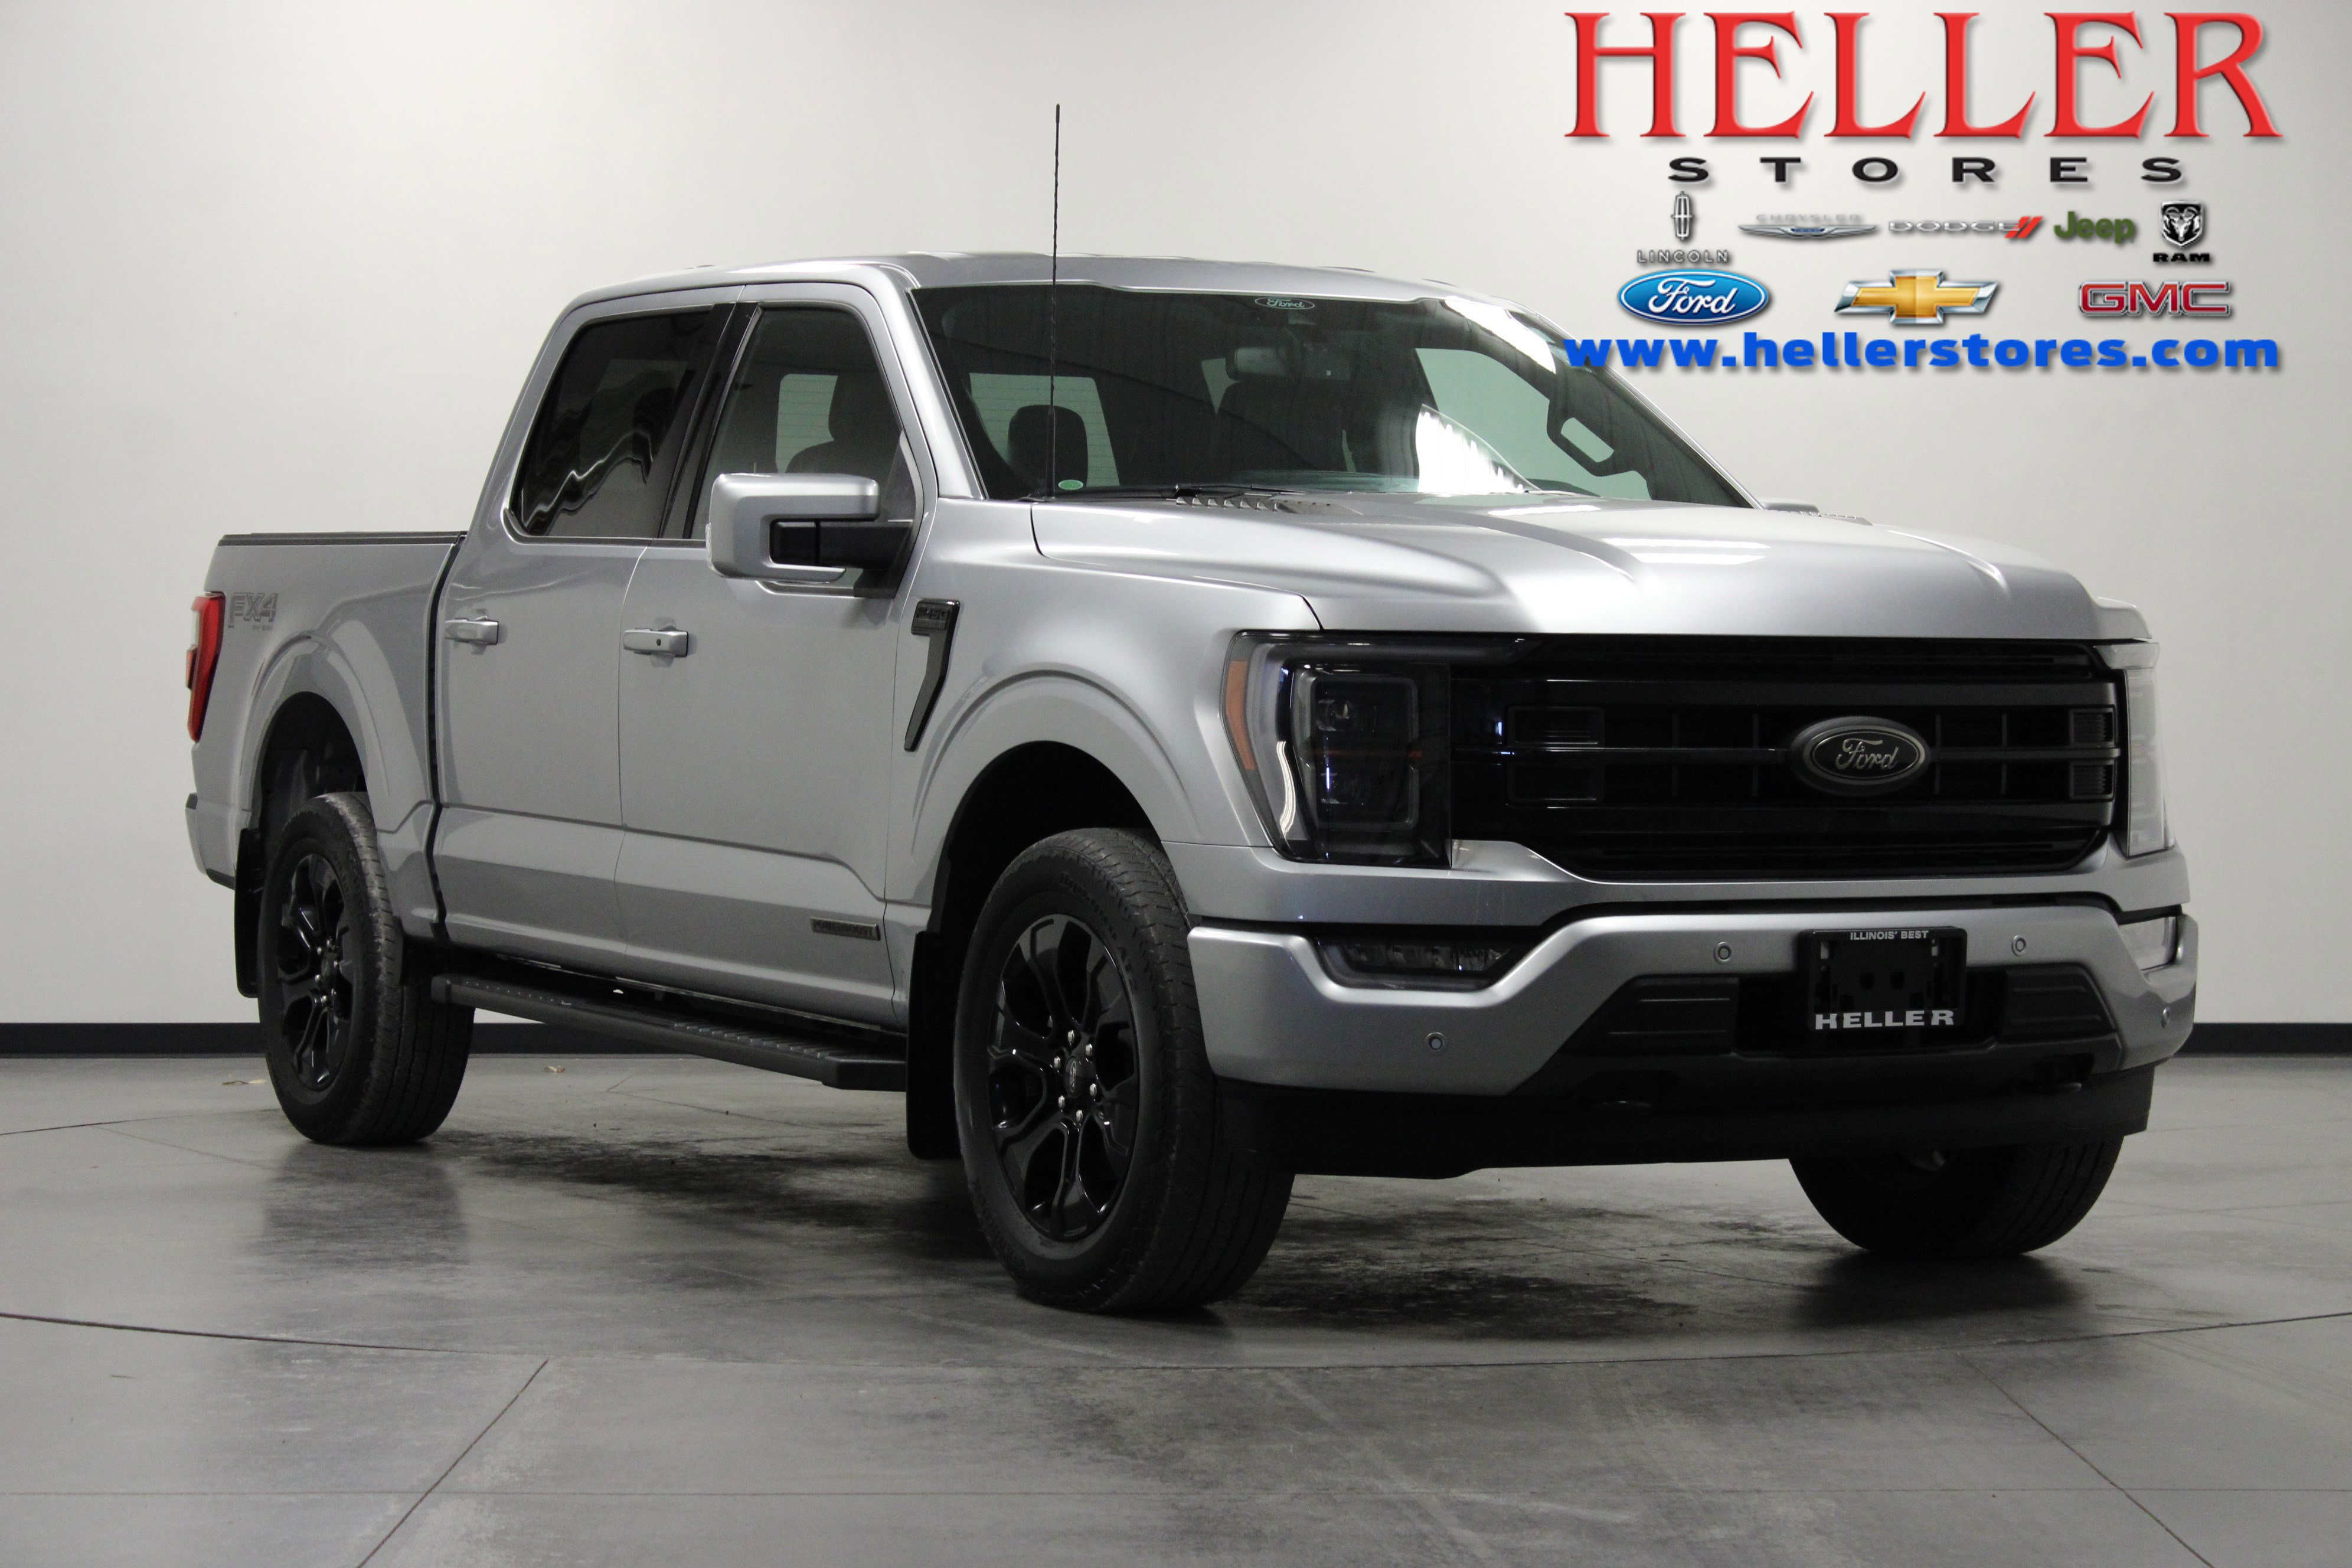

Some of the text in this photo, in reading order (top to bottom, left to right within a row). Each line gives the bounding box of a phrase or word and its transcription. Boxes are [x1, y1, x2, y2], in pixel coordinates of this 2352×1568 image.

[1266, 298, 1305, 308] Ford
[227, 592, 279, 629] FX4
[1835, 738, 1899, 770] Ford
[1900, 930, 1929, 939] BEST
[1815, 1009, 1955, 1030] HELLER
